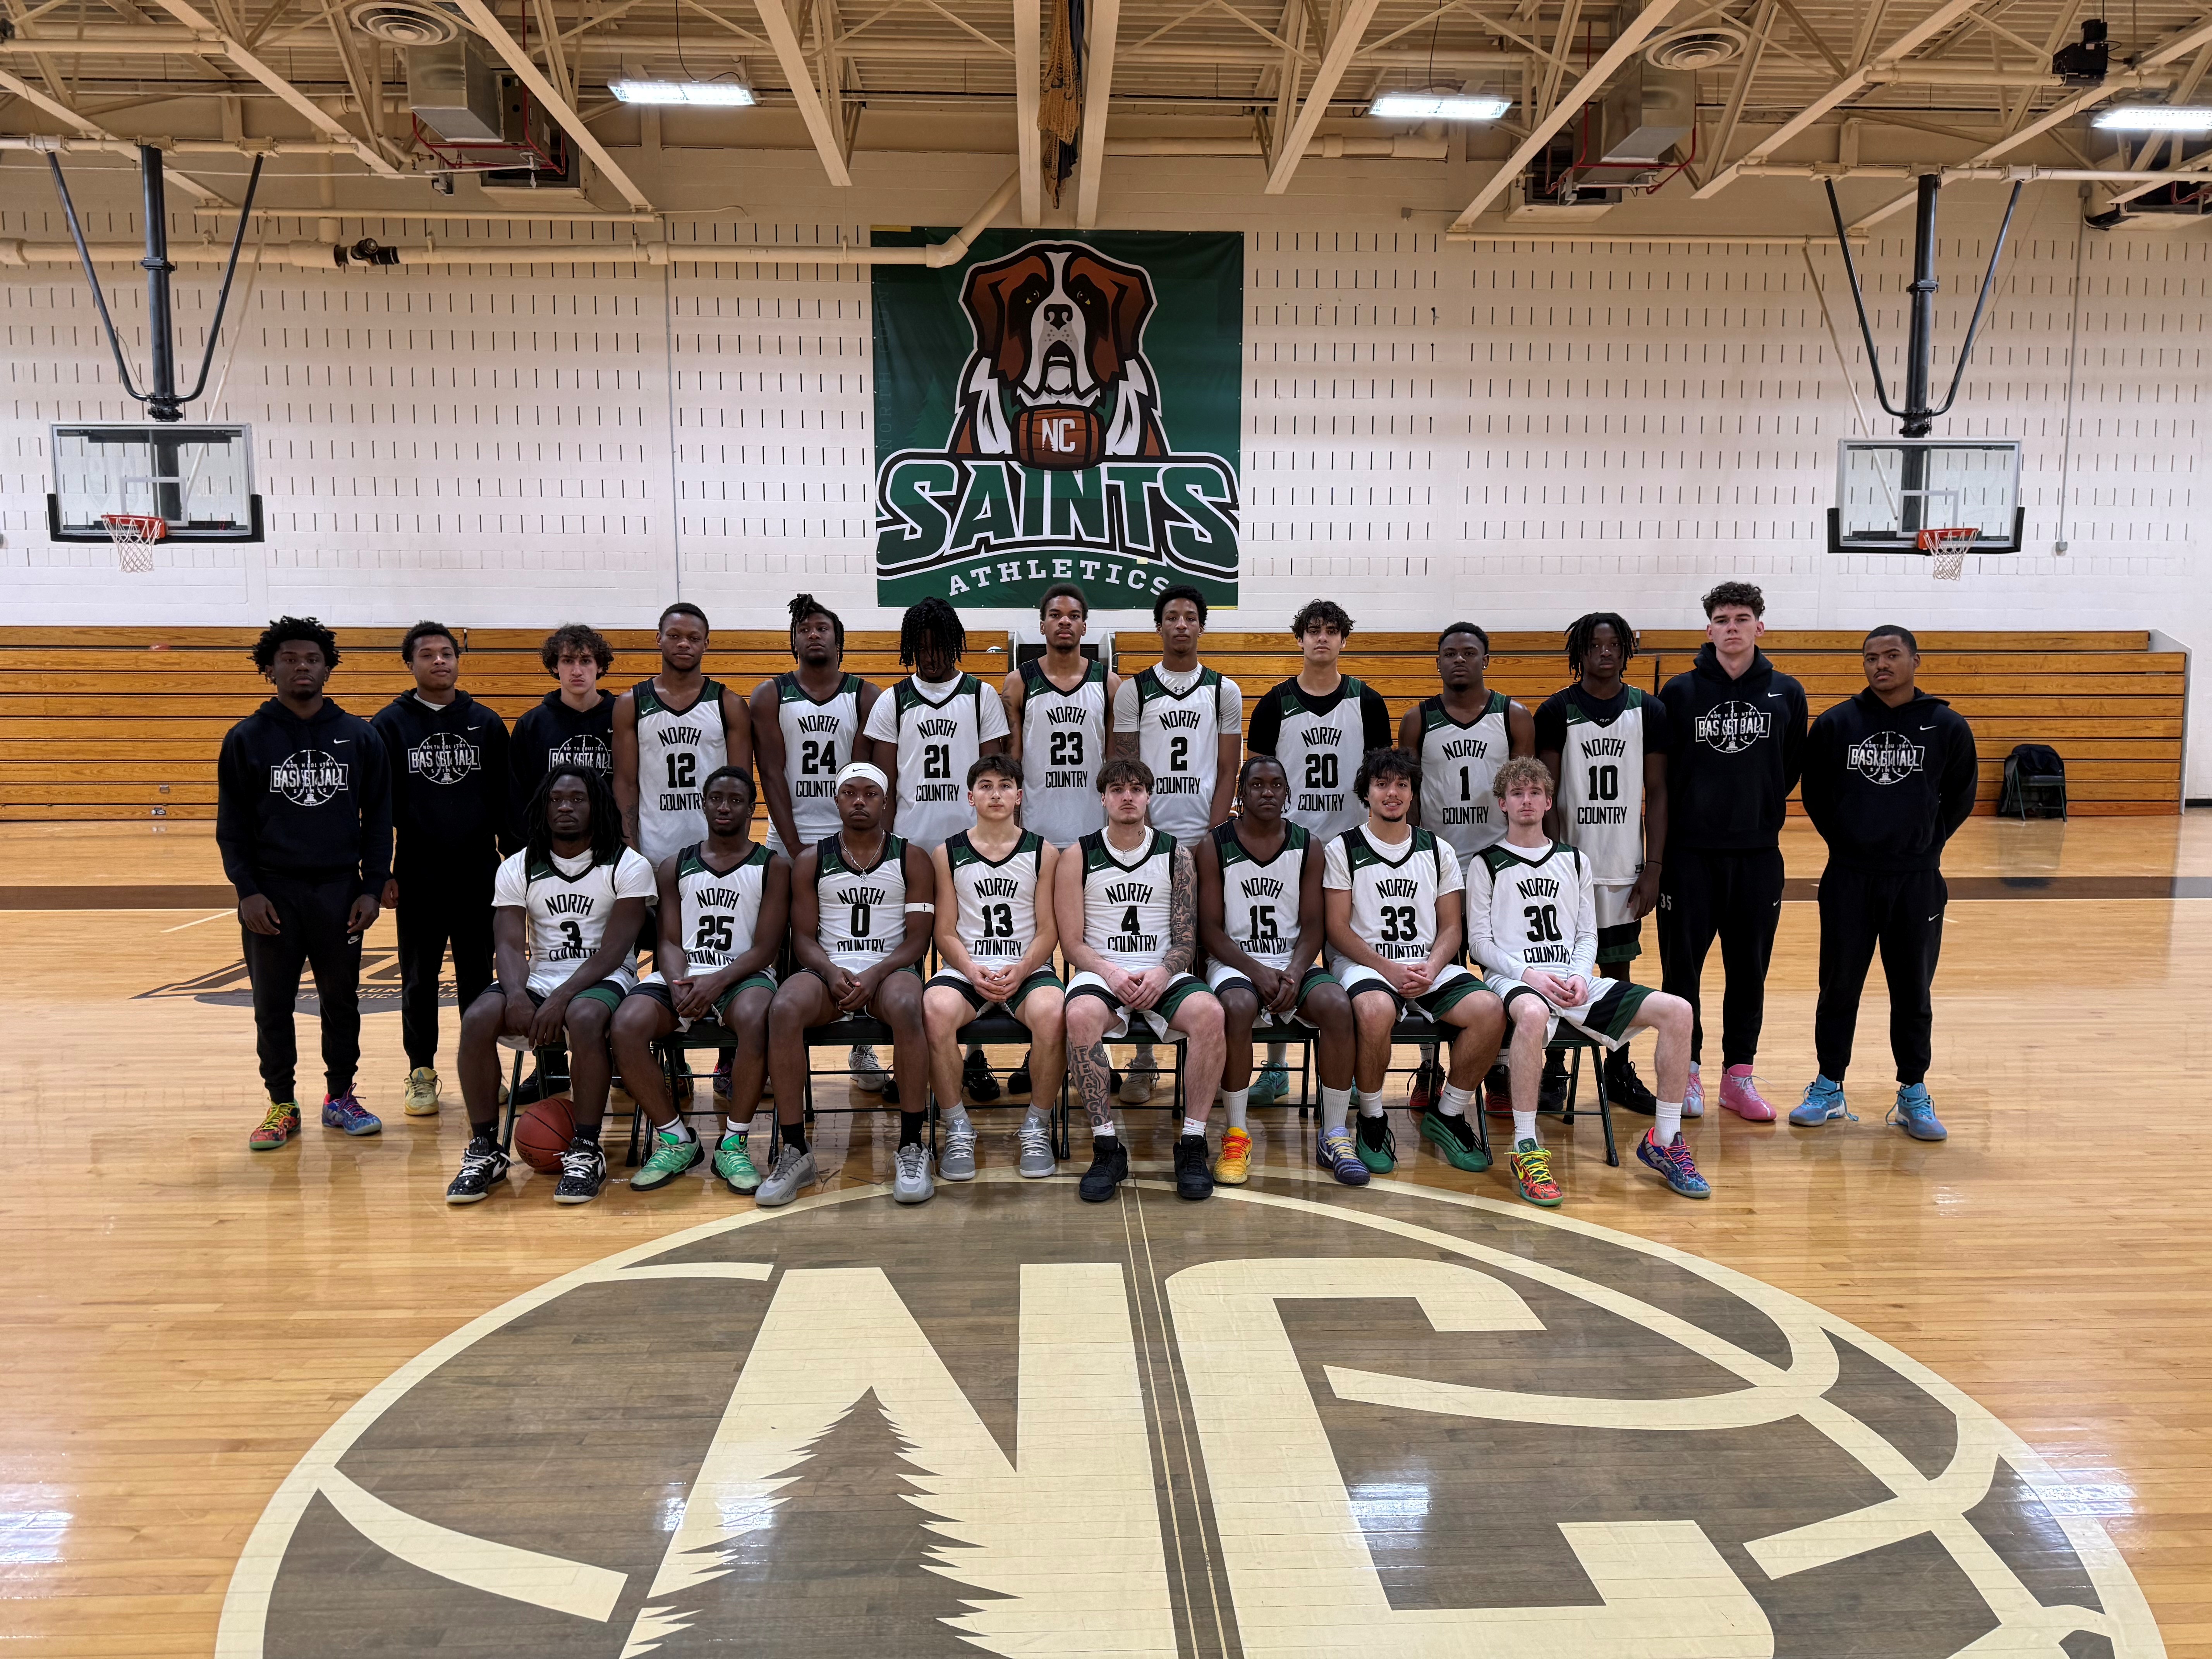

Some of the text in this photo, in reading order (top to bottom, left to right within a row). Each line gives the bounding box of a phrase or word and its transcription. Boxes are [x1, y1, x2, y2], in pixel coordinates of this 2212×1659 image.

[879, 371, 892, 451] NORTH
[1042, 419, 1075, 452] NC
[876, 454, 1239, 578] SAINTS
[949, 558, 1169, 597] ATHLETICS
[798, 715, 839, 735] NORTH
[1046, 706, 1086, 725] NORTH
[1159, 710, 1201, 730] NORTH
[658, 726, 701, 747] NORTH
[917, 719, 957, 739] NORTH
[1301, 727, 1342, 748] NORTH
[1698, 717, 1766, 737] BASKETBALL
[412, 750, 477, 768] BASKETBALL
[802, 740, 836, 775] 24
[1050, 732, 1083, 765] 23
[1171, 737, 1188, 771] 2
[1442, 740, 1488, 761] NORTH
[1581, 738, 1626, 759] NORTH
[1851, 749, 1920, 766] BASKETBALL
[552, 752, 612, 769] BASKETBALL
[666, 753, 696, 788] 12
[924, 745, 950, 778] 21
[1305, 754, 1338, 788] 20
[274, 768, 345, 787] BASKETBALL
[1045, 771, 1087, 788] COUNTRY
[1156, 777, 1200, 795] COUNTRY
[1460, 766, 1470, 801] 1
[1589, 765, 1618, 800] 10
[796, 780, 836, 798] COUNTR
[915, 784, 960, 802] COUNTRY
[1298, 793, 1344, 812] COUNTRY
[1443, 806, 1489, 825] COUNTRY
[1577, 806, 1627, 824] COUNTRY
[696, 888, 740, 910] NORTH
[837, 888, 885, 905] NORTH
[974, 878, 1018, 899] NORTH
[1105, 883, 1153, 905] NORTH
[1241, 878, 1283, 899] NORTH
[1376, 879, 1418, 899] NORTH
[1516, 878, 1559, 899] NORTH
[545, 894, 594, 916] NORTH
[1661, 893, 1671, 911] 35
[851, 903, 870, 938] 0
[982, 903, 1013, 937] 13
[1121, 906, 1140, 935] 4
[1249, 905, 1277, 940] 15
[1381, 906, 1417, 941] 33
[1524, 904, 1563, 942] 30
[560, 921, 582, 949] 3
[696, 915, 734, 951] 25
[1108, 935, 1157, 952] COUNTRY
[549, 947, 600, 961] COUNTR
[838, 939, 885, 952] COUNTRY
[974, 939, 1021, 957] COUNTRY
[1240, 937, 1287, 955] COUNTRY
[1376, 943, 1425, 959] COUNTRY
[1523, 945, 1571, 964] COUNTRY
[620, 1257, 1774, 1659] NC
